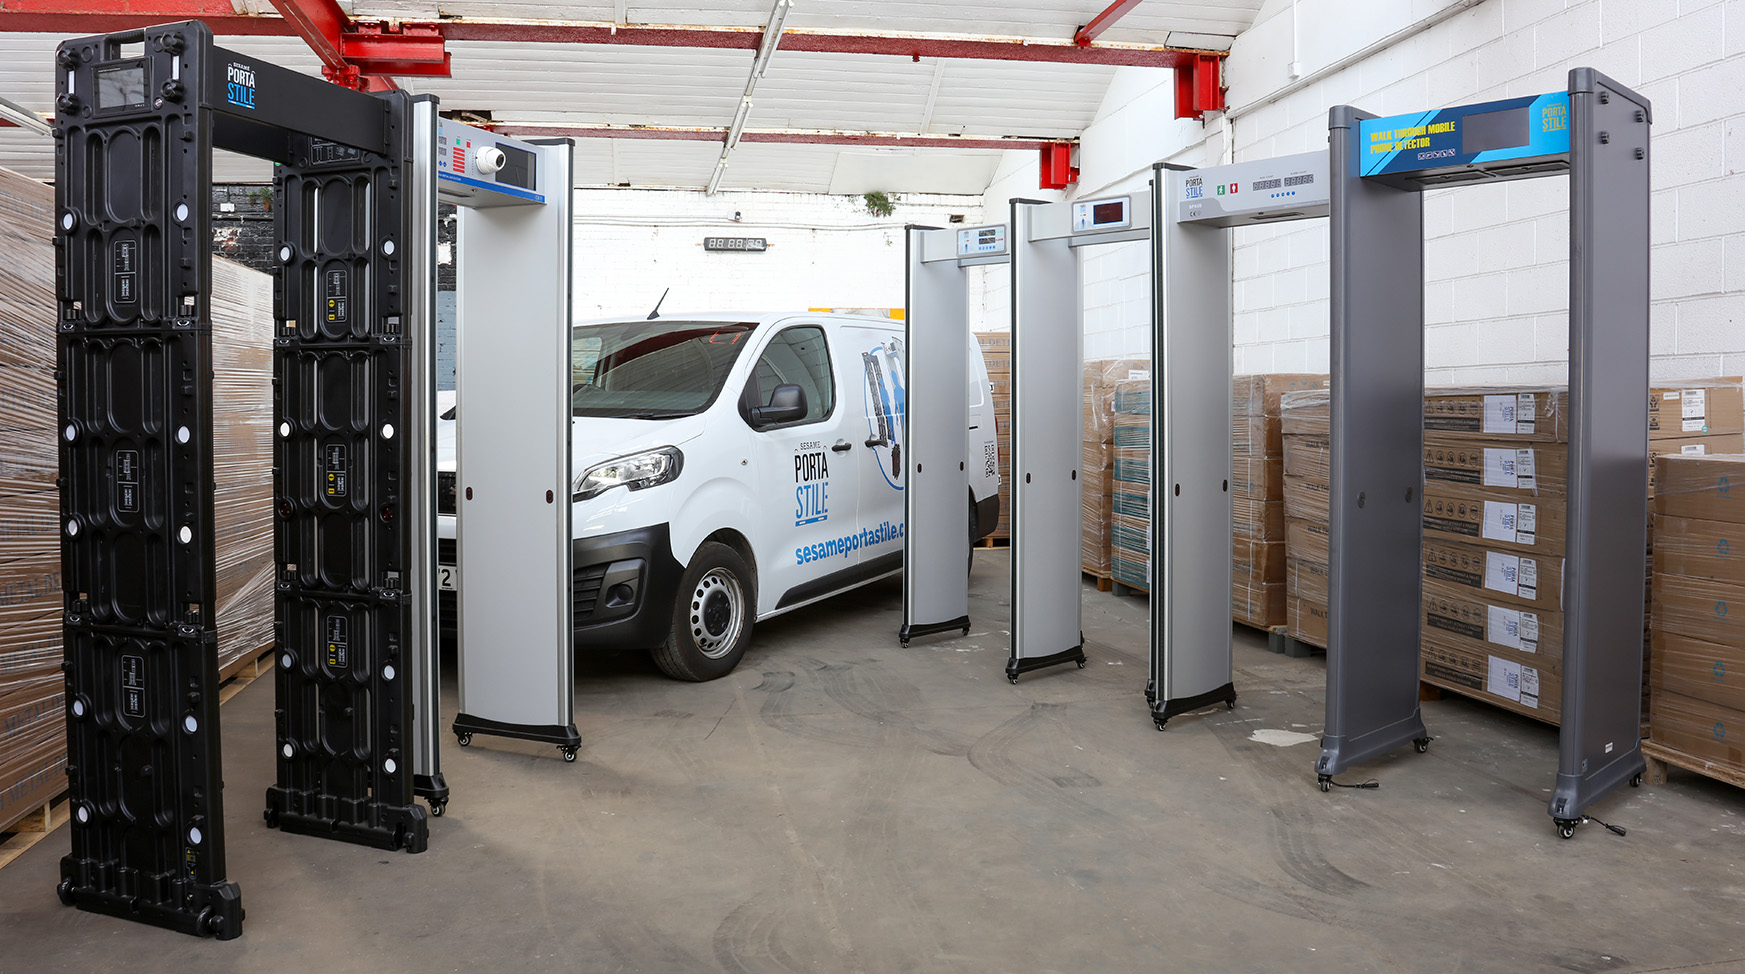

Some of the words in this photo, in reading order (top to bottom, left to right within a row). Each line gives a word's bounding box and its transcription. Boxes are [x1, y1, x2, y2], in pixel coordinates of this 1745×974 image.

[228, 66, 255, 88] PORTA
[228, 82, 255, 105] STILE
[1542, 106, 1566, 118] PORTA
[1371, 131, 1392, 142] WALK
[1394, 126, 1427, 139] THROUGH
[1428, 121, 1455, 134] MOBILE
[1542, 116, 1566, 129] STILE
[1371, 142, 1393, 154] PHONE
[1395, 137, 1430, 151] DETECTOR
[1186, 178, 1202, 187] PORTA
[1186, 186, 1203, 197] STILE
[800, 441, 821, 450] SESAME
[795, 451, 829, 483] PORTA
[796, 482, 828, 518] STILE
[795, 521, 904, 565] sesameportastile.c
